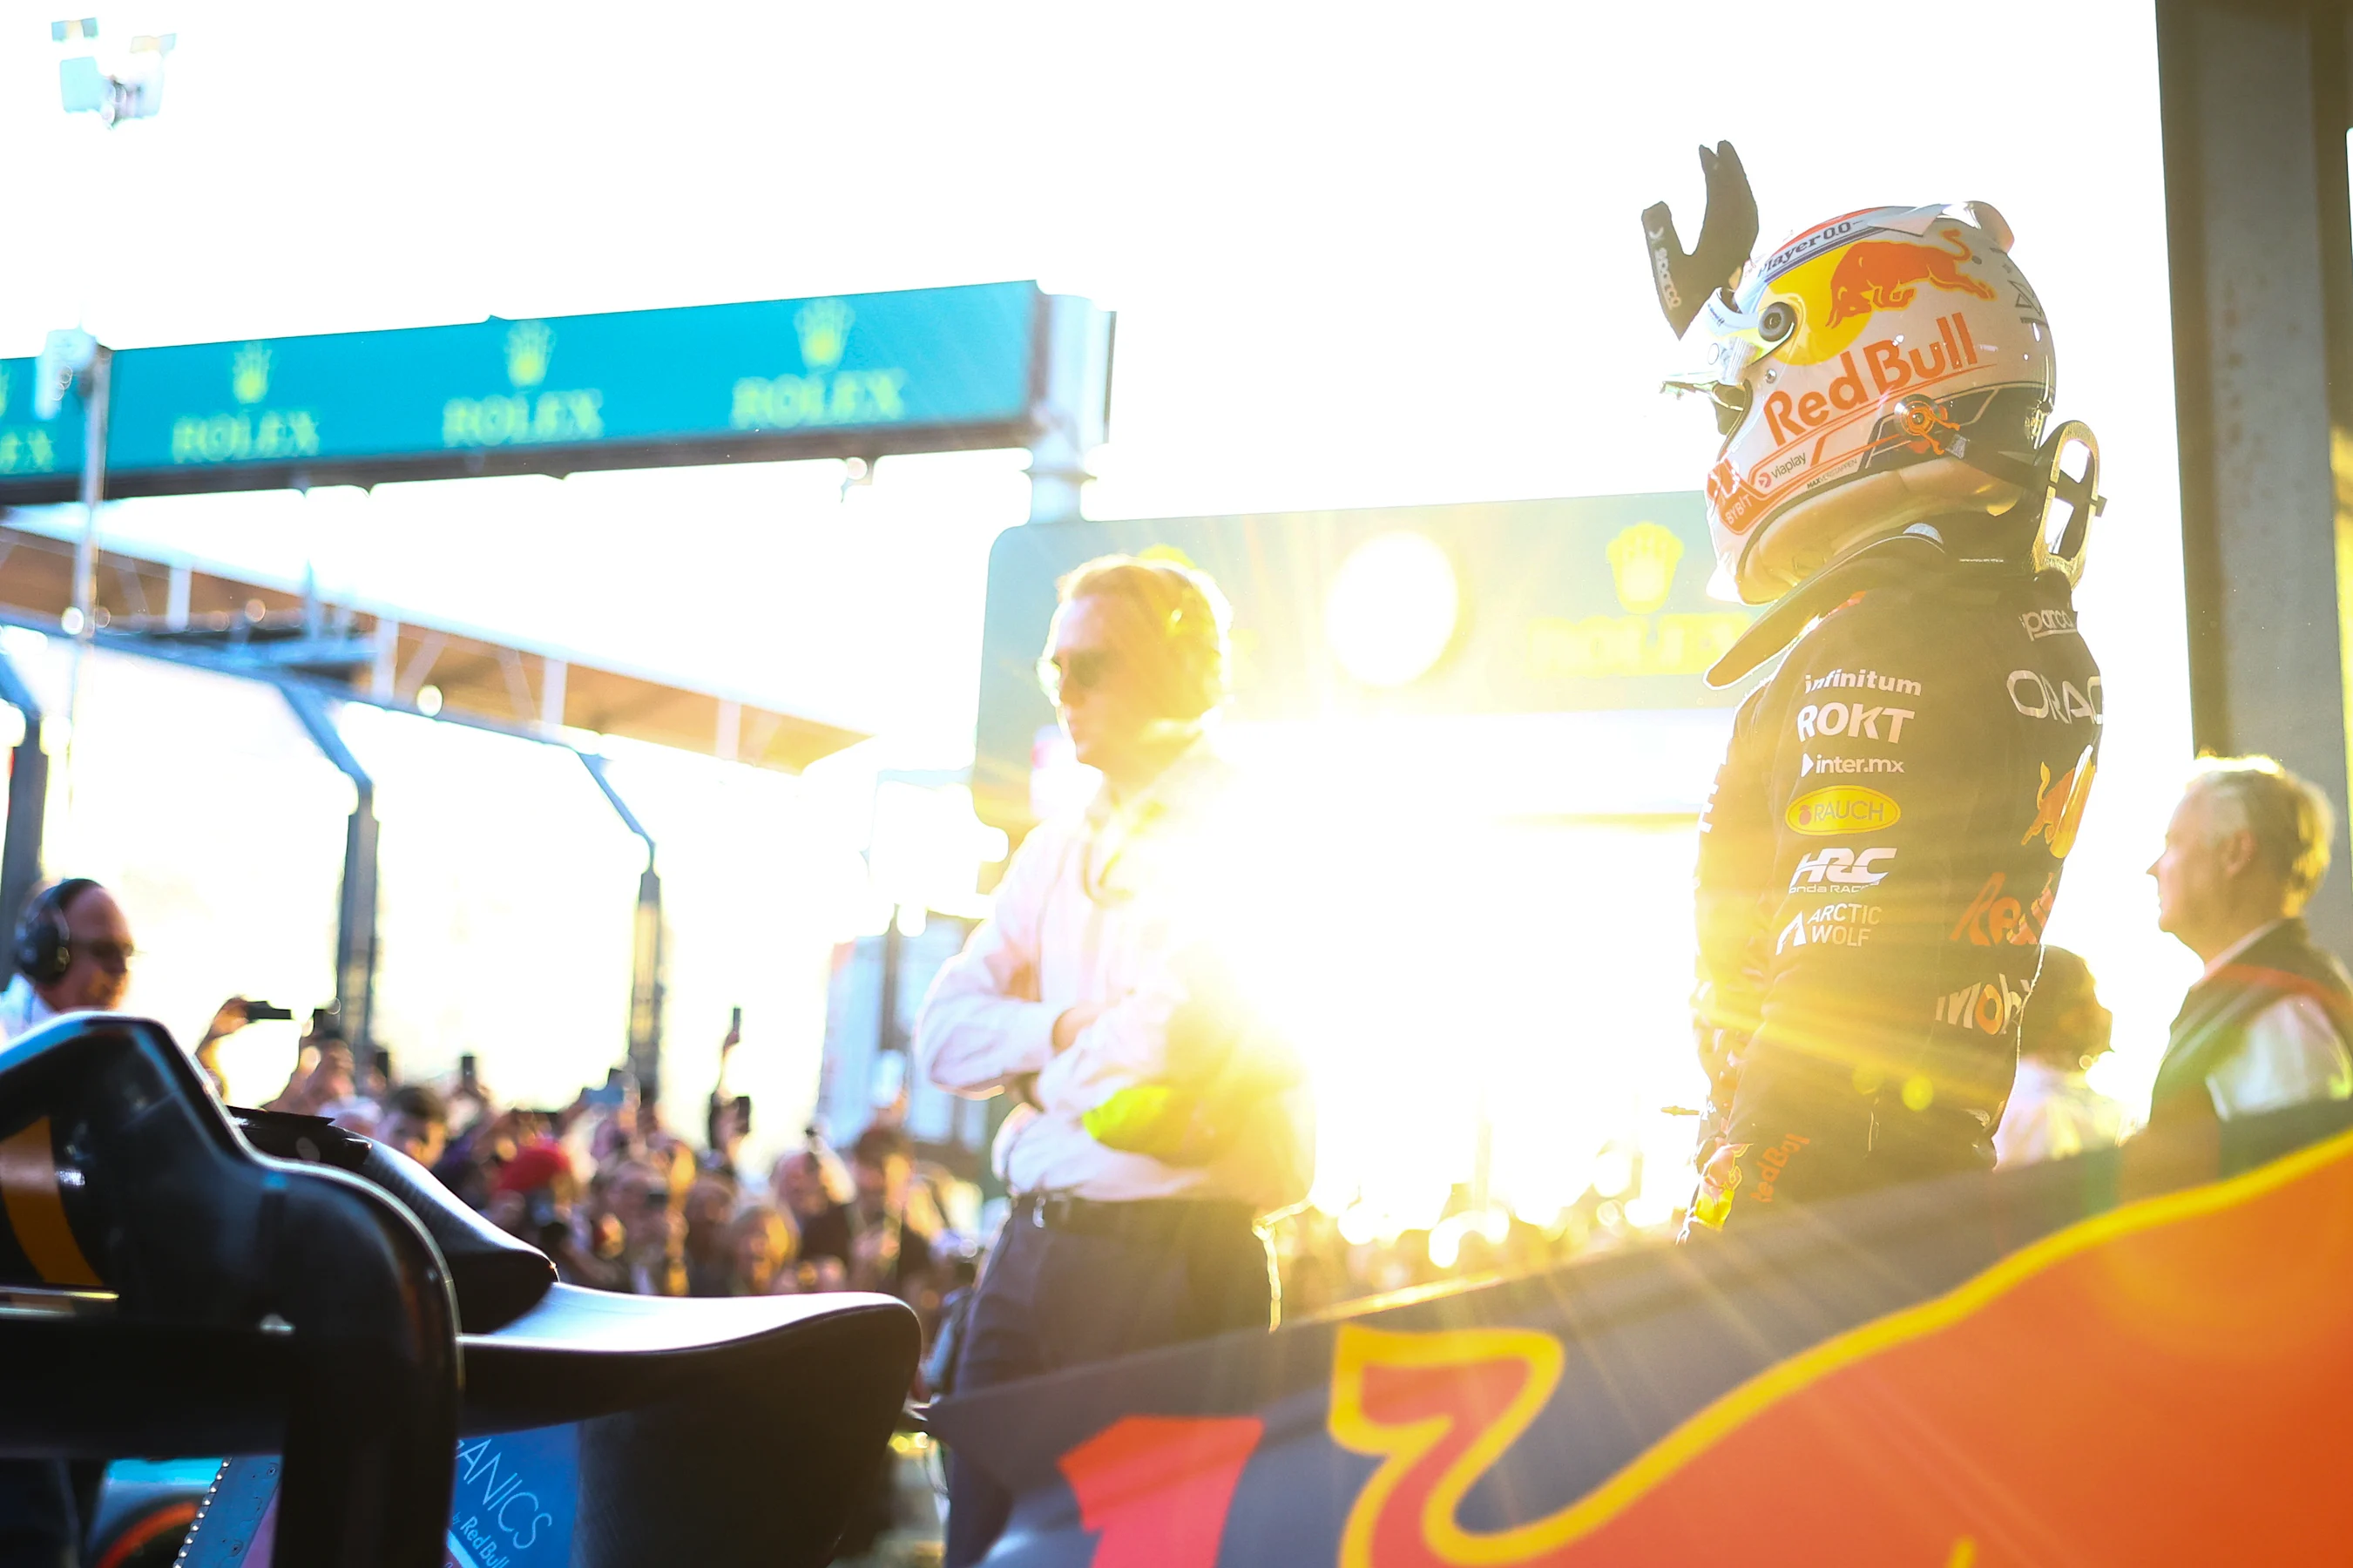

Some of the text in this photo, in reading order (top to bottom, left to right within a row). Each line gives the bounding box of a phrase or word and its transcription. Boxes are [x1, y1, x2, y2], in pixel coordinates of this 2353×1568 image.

[1763, 311, 1978, 448] Red Bull
[729, 368, 907, 430] ROLEX
[443, 389, 605, 448] ROLEX
[172, 409, 321, 463] ROLEX
[1770, 451, 1808, 479] viaplay
[1724, 493, 1754, 525] BYBIT
[2018, 609, 2075, 642] parco
[1805, 669, 1922, 697] infinitum
[1796, 702, 1916, 744] ROKT
[1815, 754, 1905, 774] inter.mx
[1813, 801, 1884, 822] RAUCH
[1789, 848, 1898, 893] HRC
[1806, 902, 1883, 926] ARCTIC
[1810, 924, 1872, 948] WOLF
[456, 1439, 552, 1549] ANICS
[460, 1515, 492, 1551] Red
